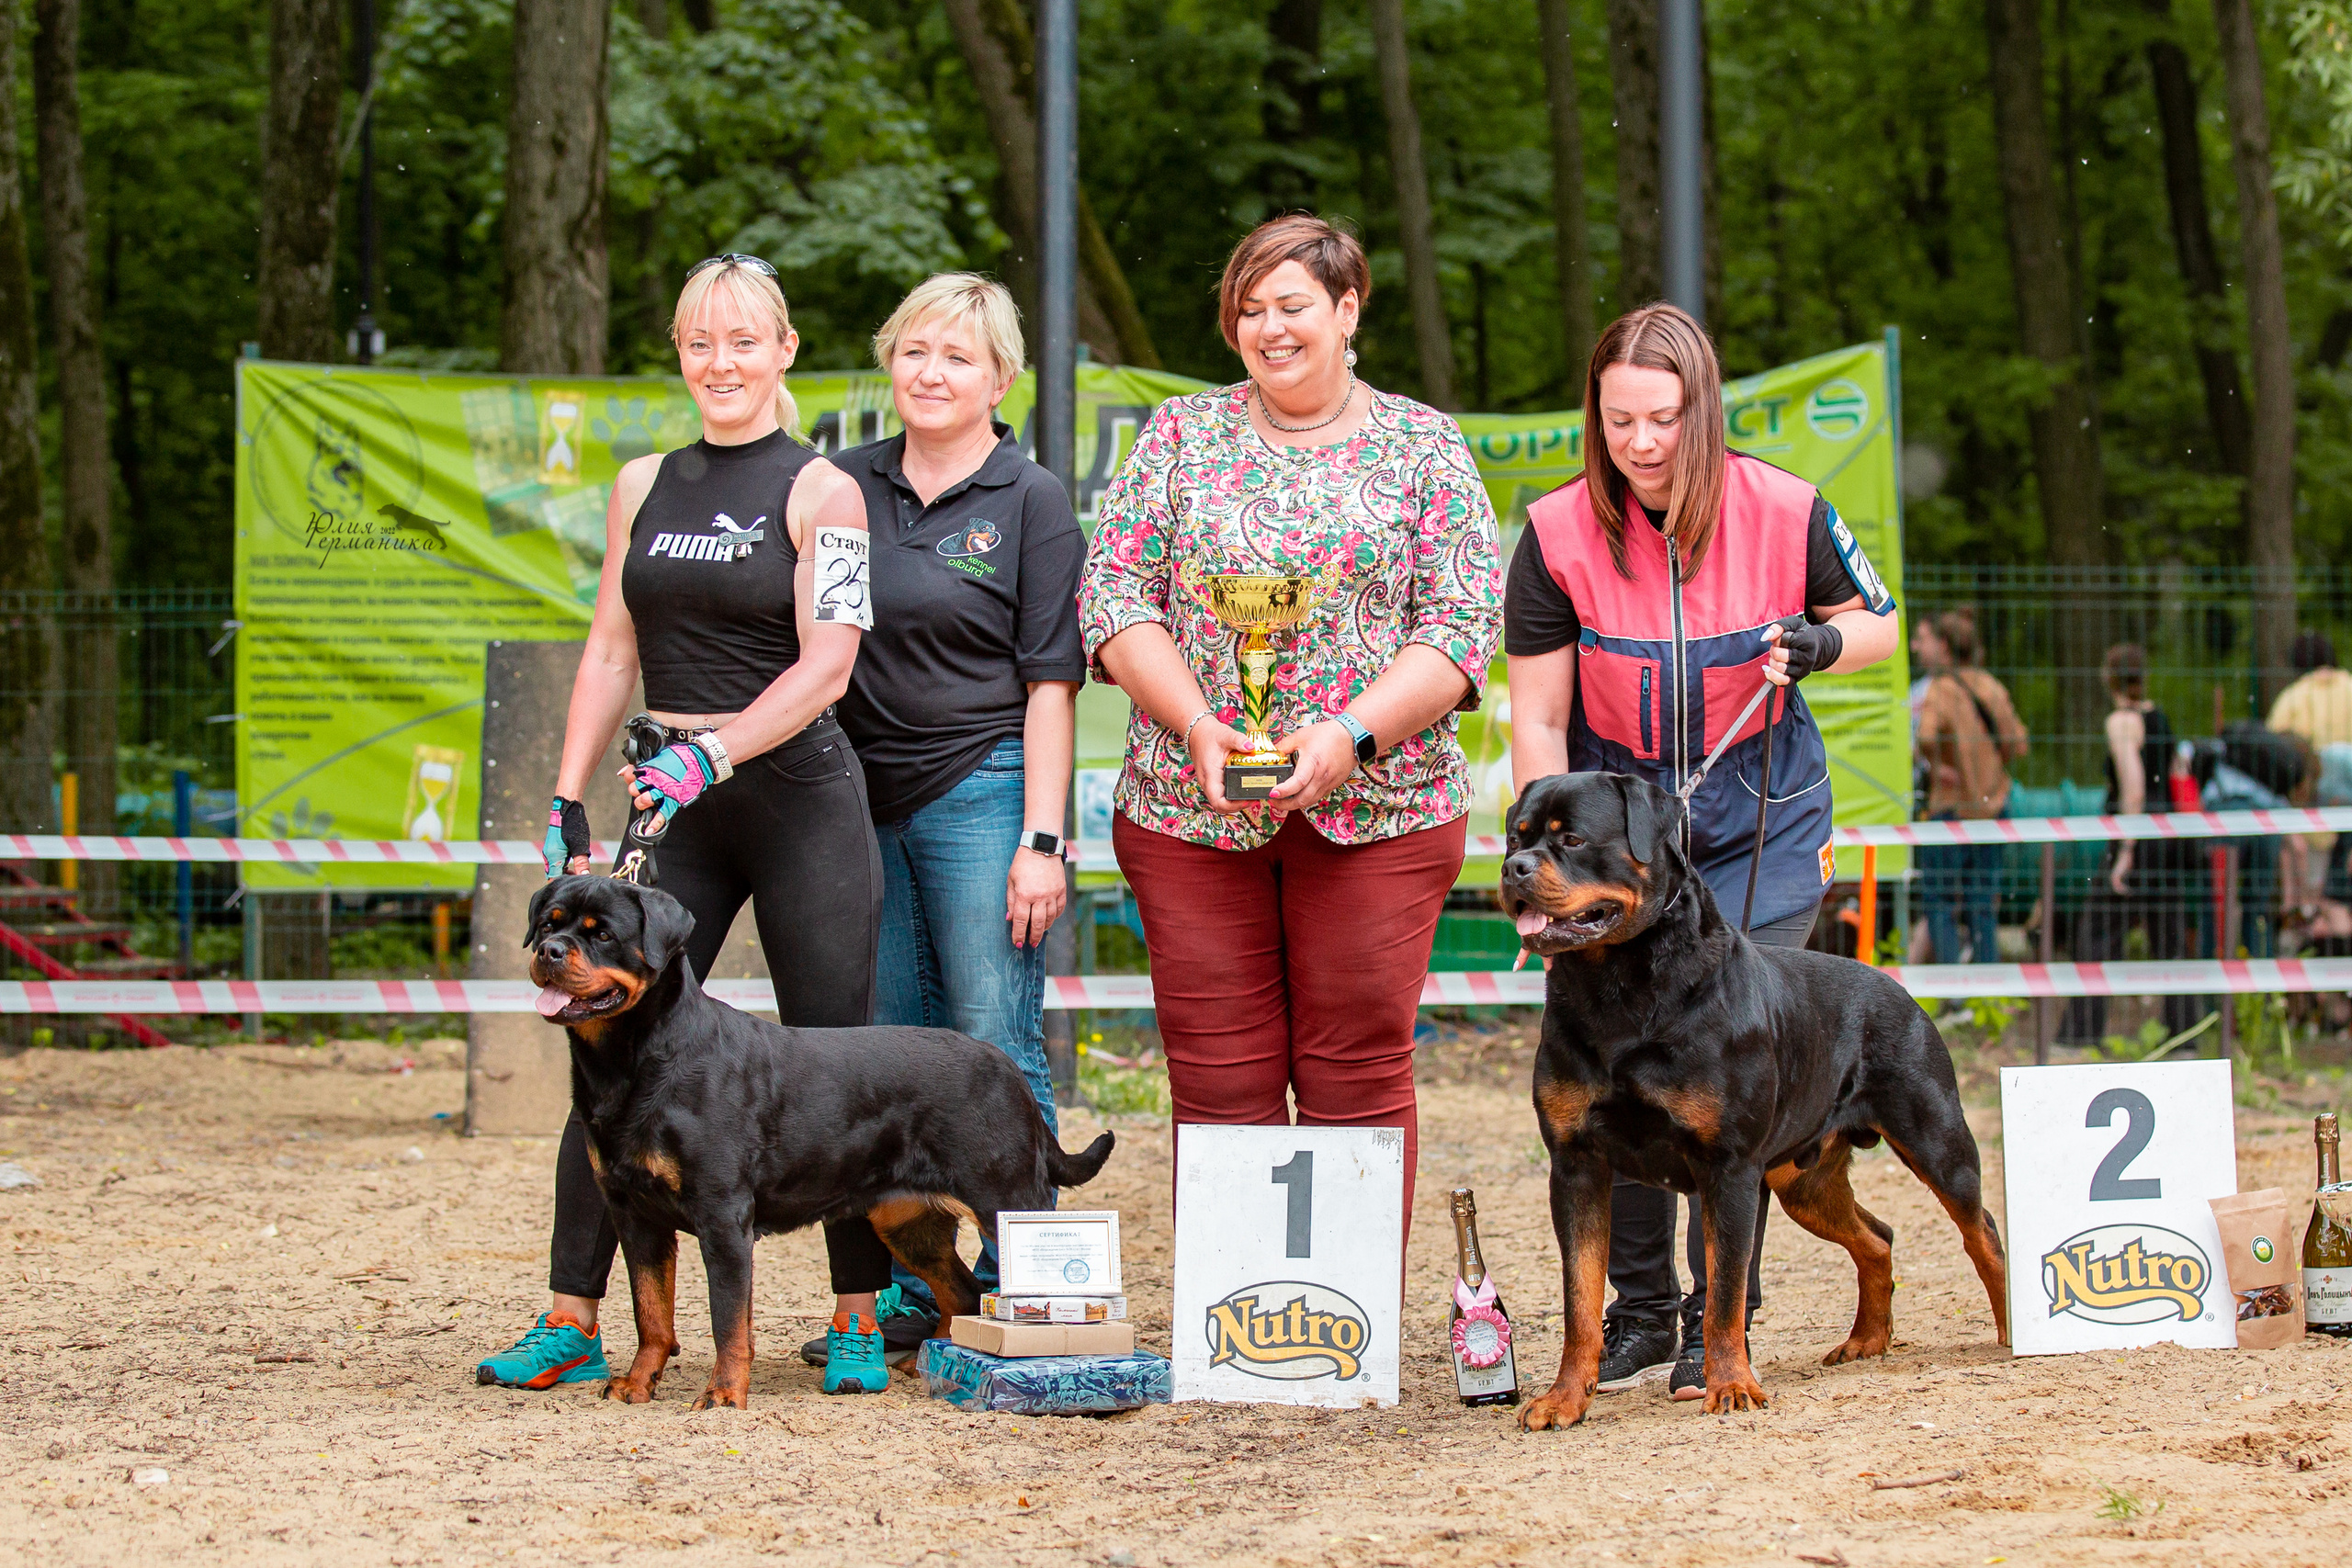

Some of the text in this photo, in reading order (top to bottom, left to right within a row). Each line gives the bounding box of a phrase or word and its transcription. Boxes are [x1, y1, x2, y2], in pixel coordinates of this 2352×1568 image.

[648, 533, 736, 562] PUMA
[820, 532, 867, 555] Стаут
[947, 558, 985, 578] olburd
[967, 555, 997, 574] kennel
[820, 558, 867, 609] 25
[2086, 1088, 2161, 1201] 2
[1272, 1150, 1314, 1258] 1
[2041, 1237, 2204, 1321] Nutro
[1206, 1295, 1363, 1380] Nutro
